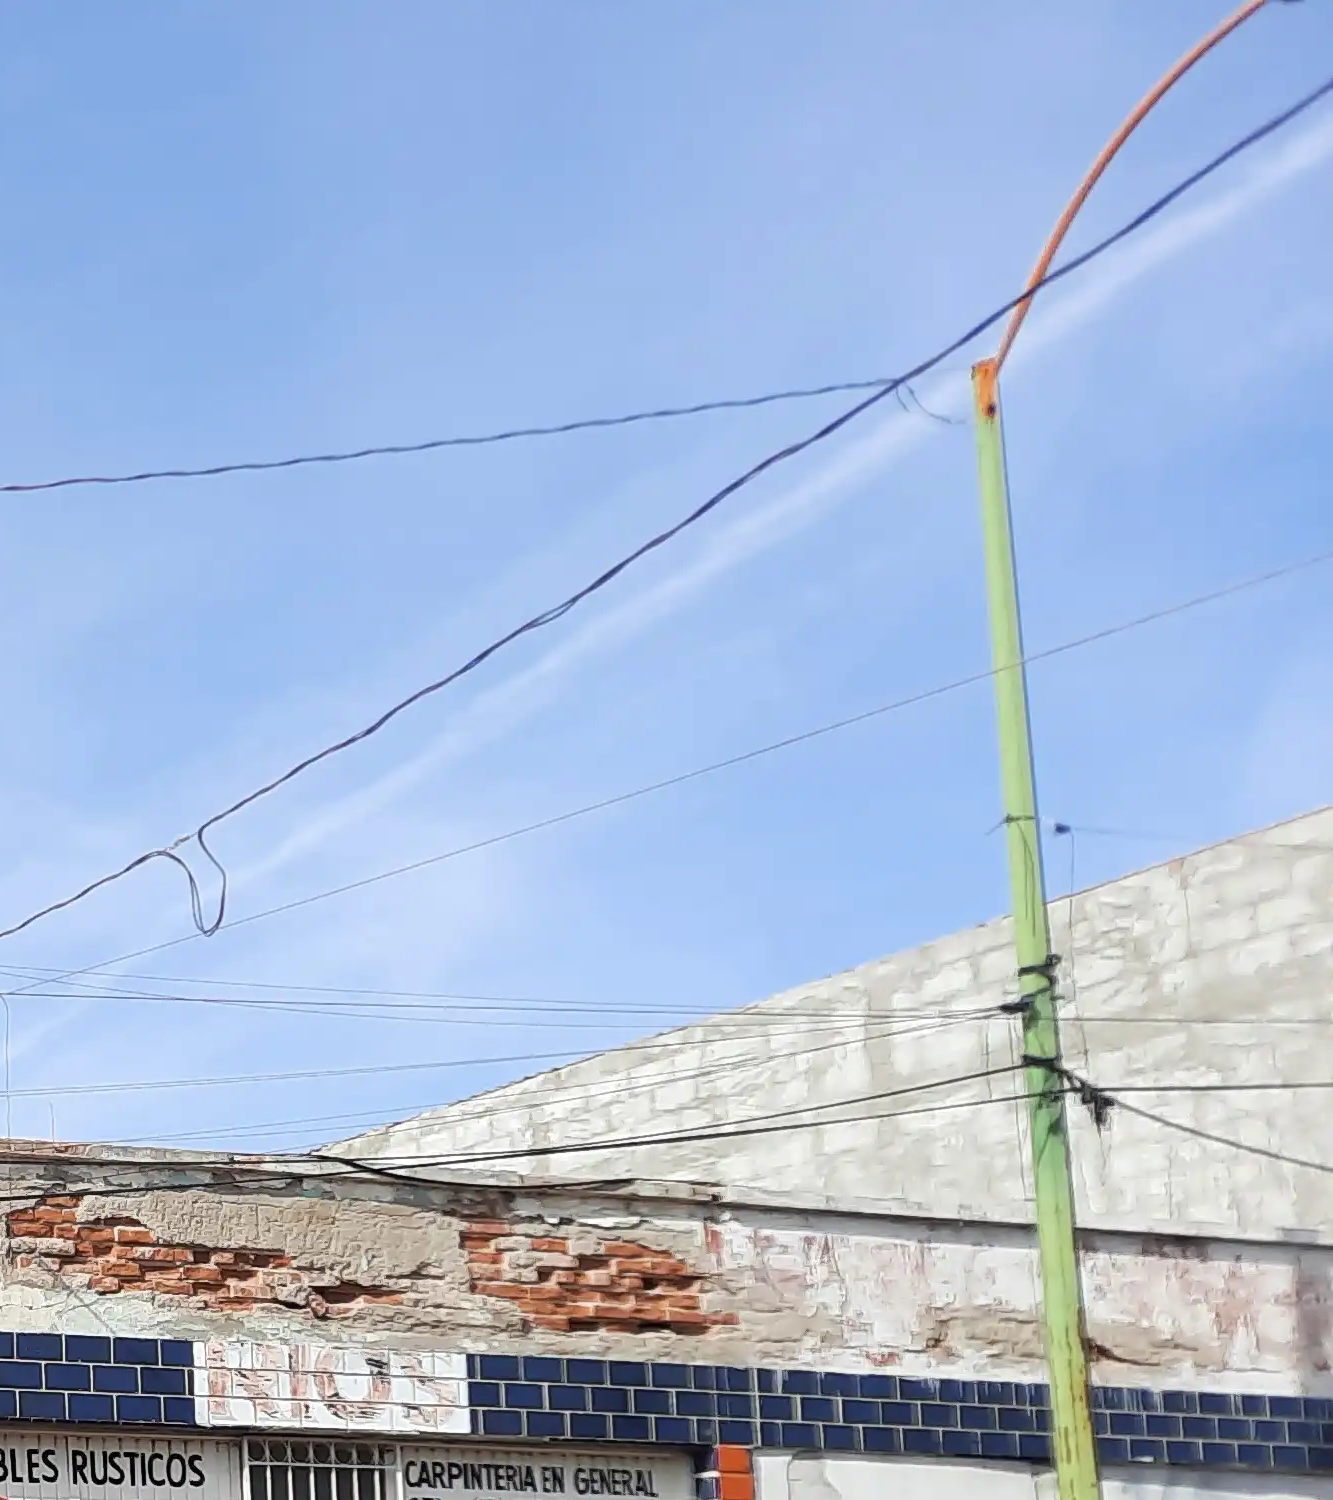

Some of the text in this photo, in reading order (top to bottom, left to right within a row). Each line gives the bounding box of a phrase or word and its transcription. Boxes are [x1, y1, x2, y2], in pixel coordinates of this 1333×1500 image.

[71, 1449, 206, 1488] RUSTICOS
[404, 1460, 660, 1498] CARPINTERIA EN GENERAL
